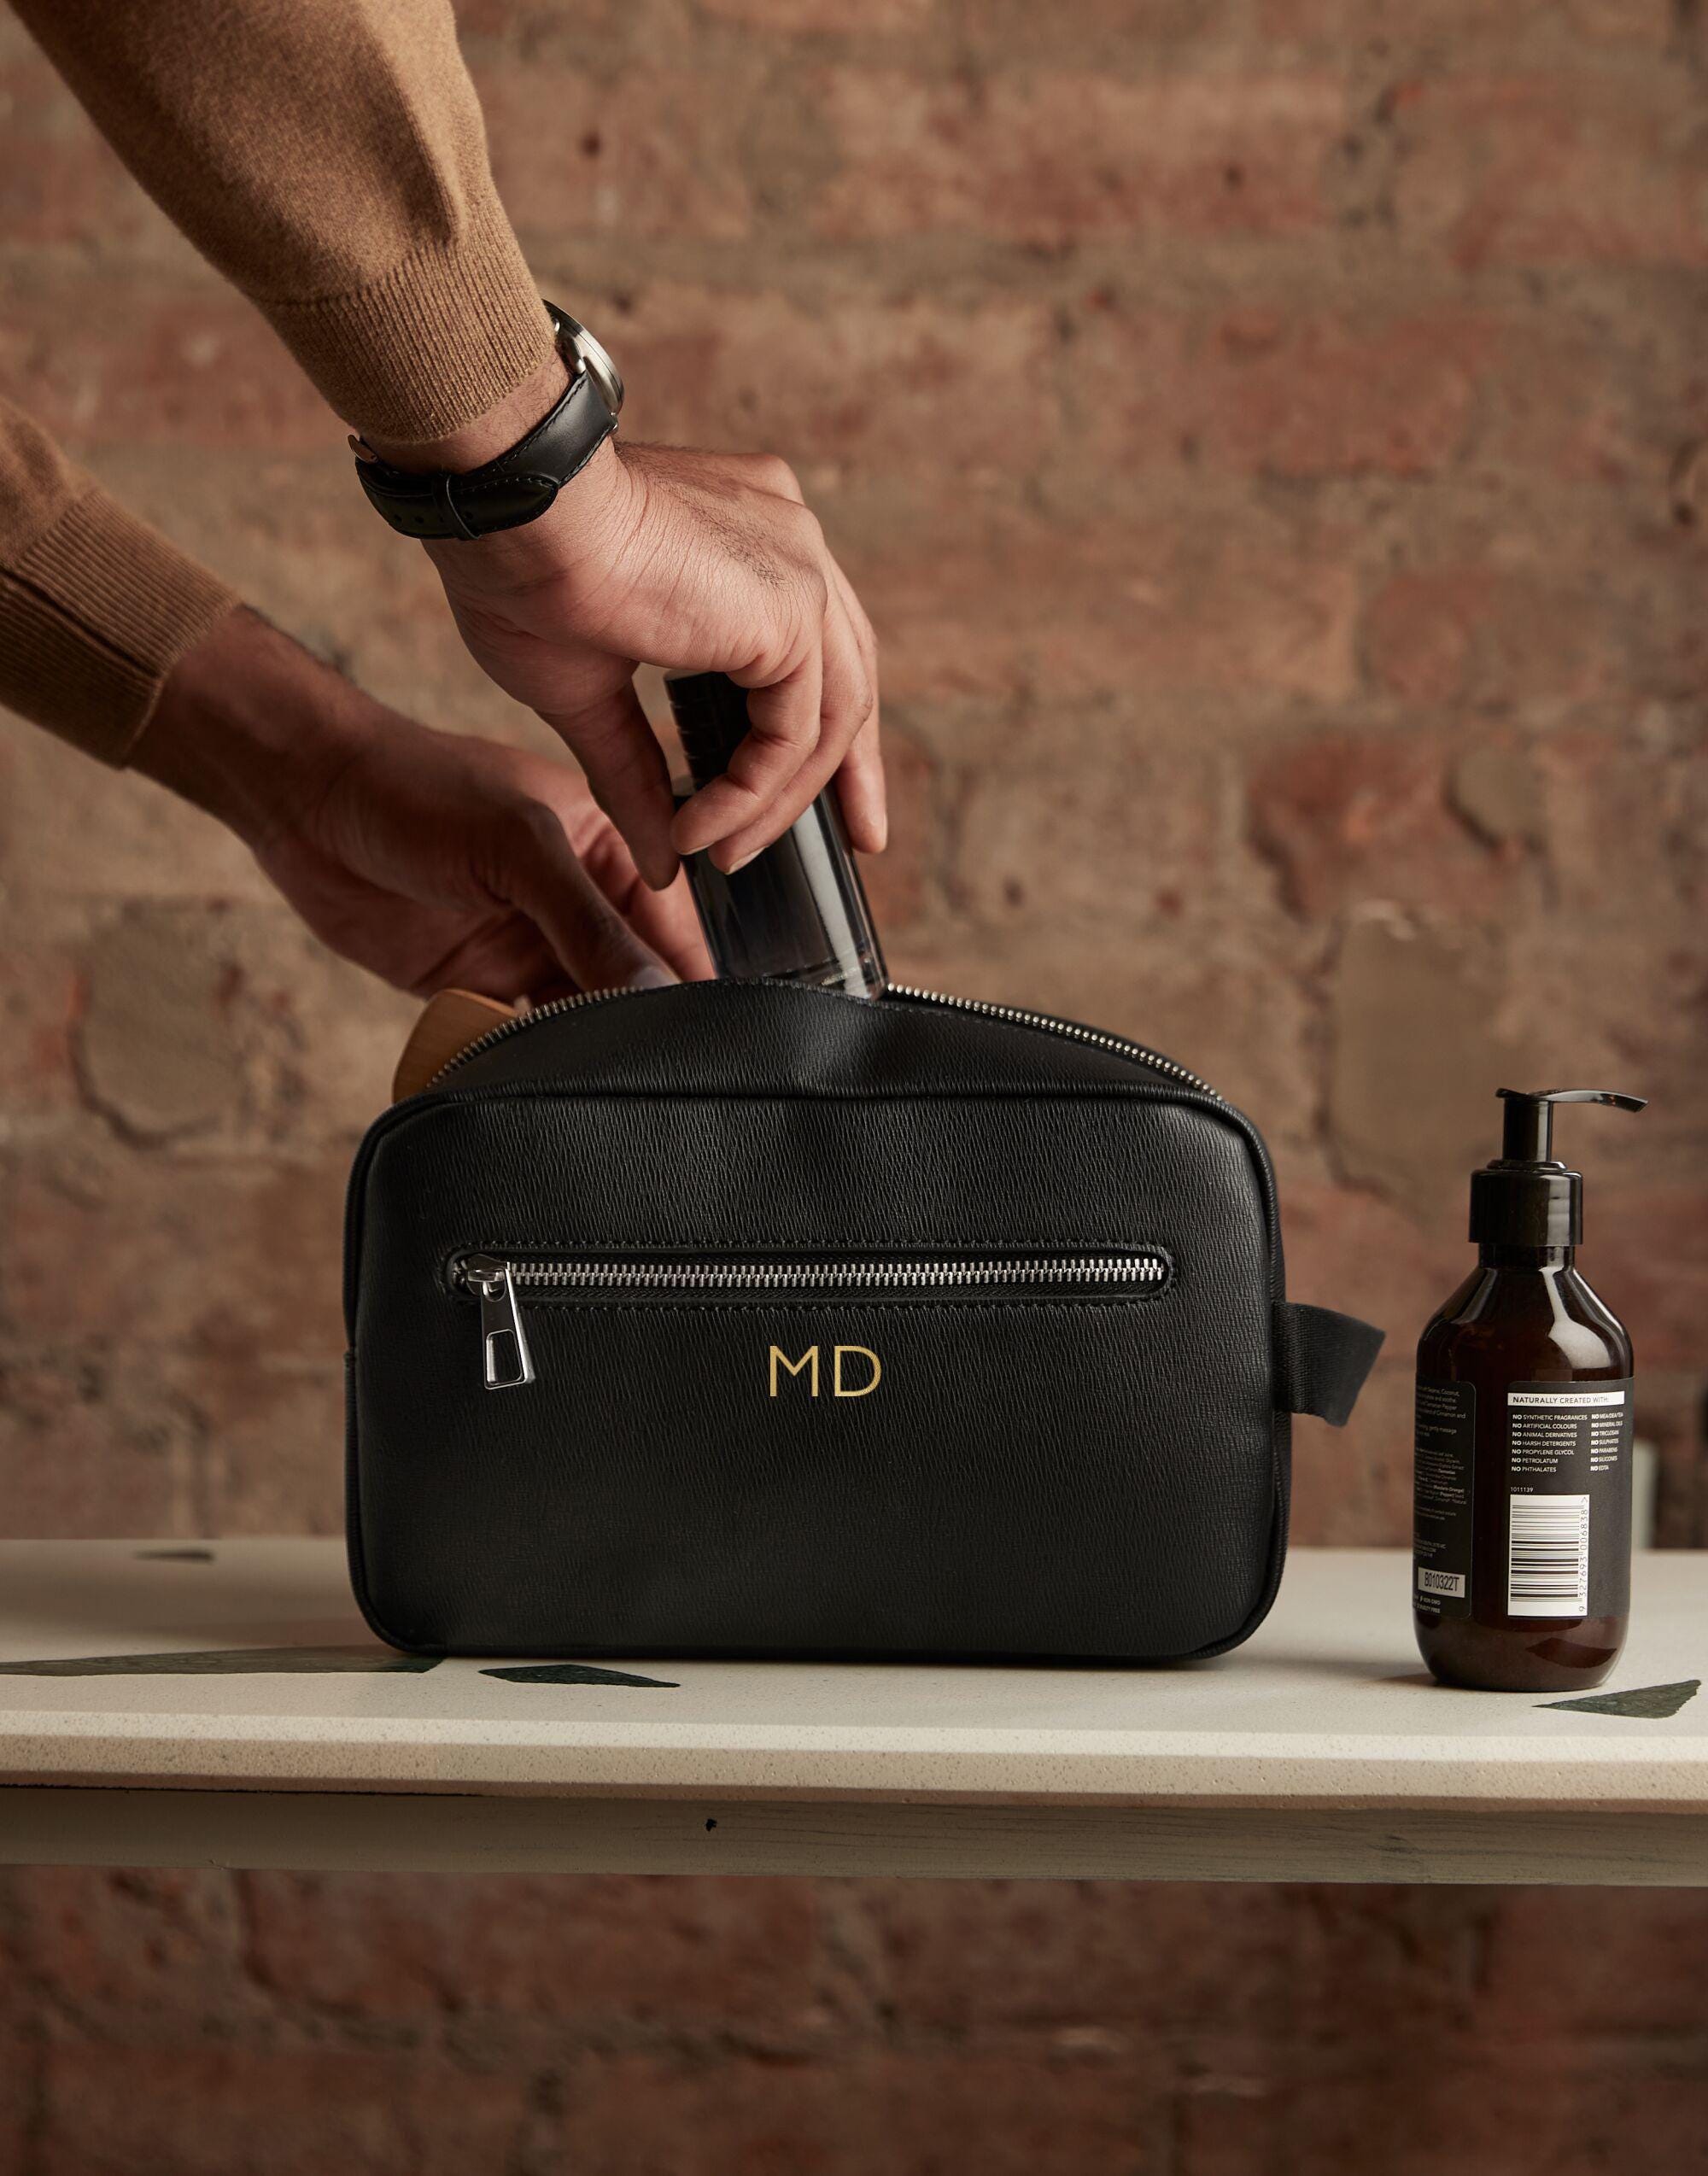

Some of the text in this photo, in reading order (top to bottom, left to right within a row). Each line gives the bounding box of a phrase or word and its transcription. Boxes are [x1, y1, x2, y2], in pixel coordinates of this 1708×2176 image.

[769, 1345, 882, 1397] MD
[1424, 1572, 1459, 1591] B010322T
[1579, 1556, 1588, 1598] 327693
